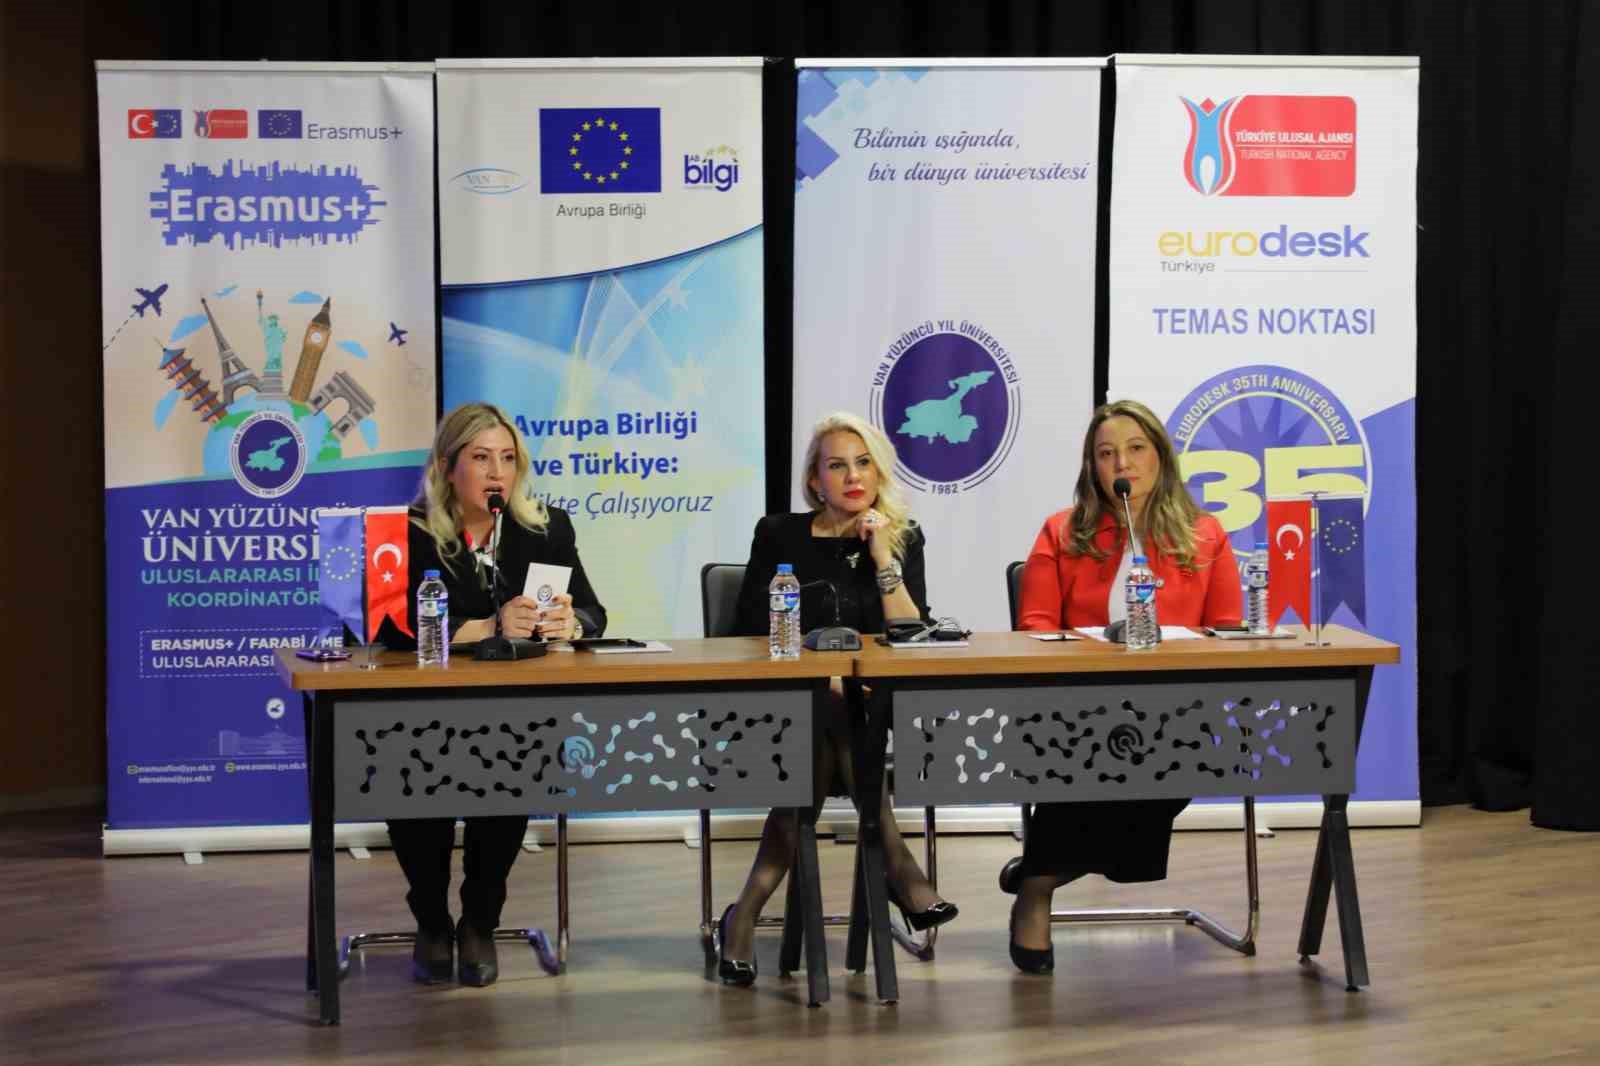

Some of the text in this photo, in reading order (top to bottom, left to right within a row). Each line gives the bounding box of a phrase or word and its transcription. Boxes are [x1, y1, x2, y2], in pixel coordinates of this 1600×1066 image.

[308, 124, 402, 139] Erasmus+
[853, 128, 927, 150] Bilimin
[1278, 131, 1315, 144] ULUSAL
[1317, 131, 1352, 144] AJANSI
[684, 154, 738, 192] bilgi
[868, 162, 1091, 186] bir dünya üniversitesi
[171, 189, 366, 222] Erasmus+
[556, 204, 605, 219] Avrupa
[1158, 224, 1371, 257] eurodesk
[1160, 261, 1215, 275] Türkiye
[1153, 308, 1375, 334] TEMAS NOKTASI
[873, 362, 890, 387] VAN
[887, 320, 934, 362] YÜZÜNCÜ
[937, 320, 956, 331] YIL
[1176, 374, 1350, 441] EURODESK 35TH ANNIVERSARY
[514, 411, 697, 441] Avrupa Birliği
[533, 452, 678, 479] ve Türkiye:
[1178, 444, 1368, 533] 35
[585, 491, 713, 519] Çalışıyoruz
[141, 509, 200, 528] VAN
[141, 530, 320, 562] ÜNİVERSİ
[141, 568, 300, 584] ULUSLARARASI
[168, 588, 320, 608] KOORDİNATÖR
[152, 638, 234, 651] ERASMUS+
[250, 635, 305, 649] FARABİ
[320, 637, 343, 649] ME
[153, 655, 275, 669] ULUSLARARASI
